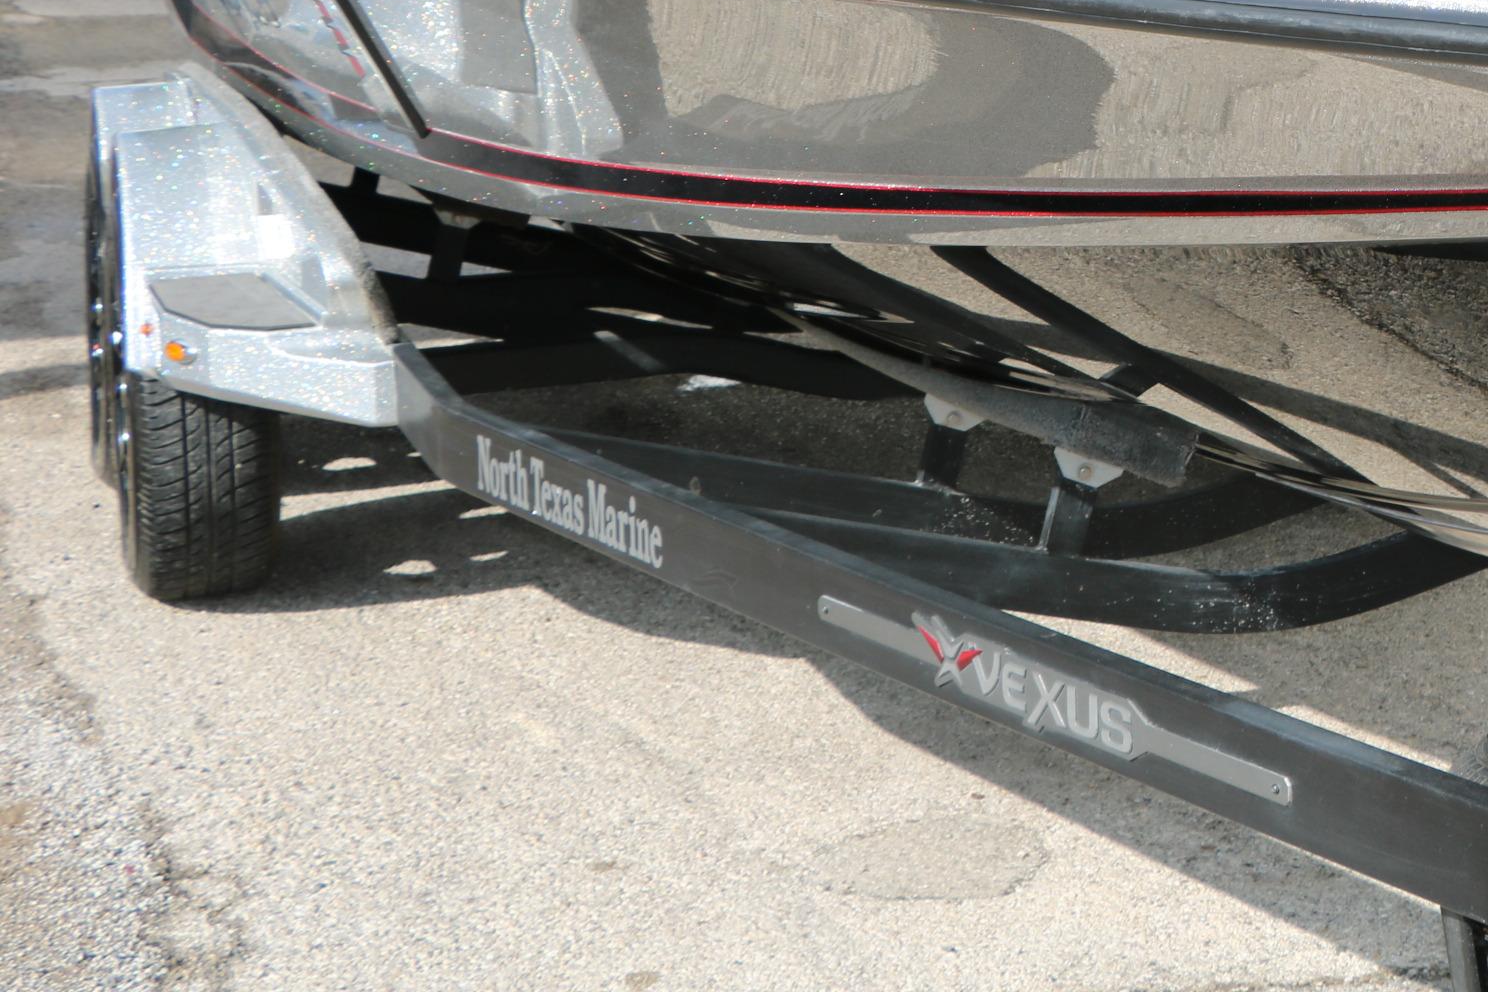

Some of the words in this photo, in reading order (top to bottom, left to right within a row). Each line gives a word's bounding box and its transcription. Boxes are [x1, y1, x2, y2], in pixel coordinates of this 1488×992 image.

[476, 434, 530, 511] North
[529, 456, 586, 536] Texas
[586, 477, 664, 569] Marine
[970, 650, 1134, 756] VEXUS
